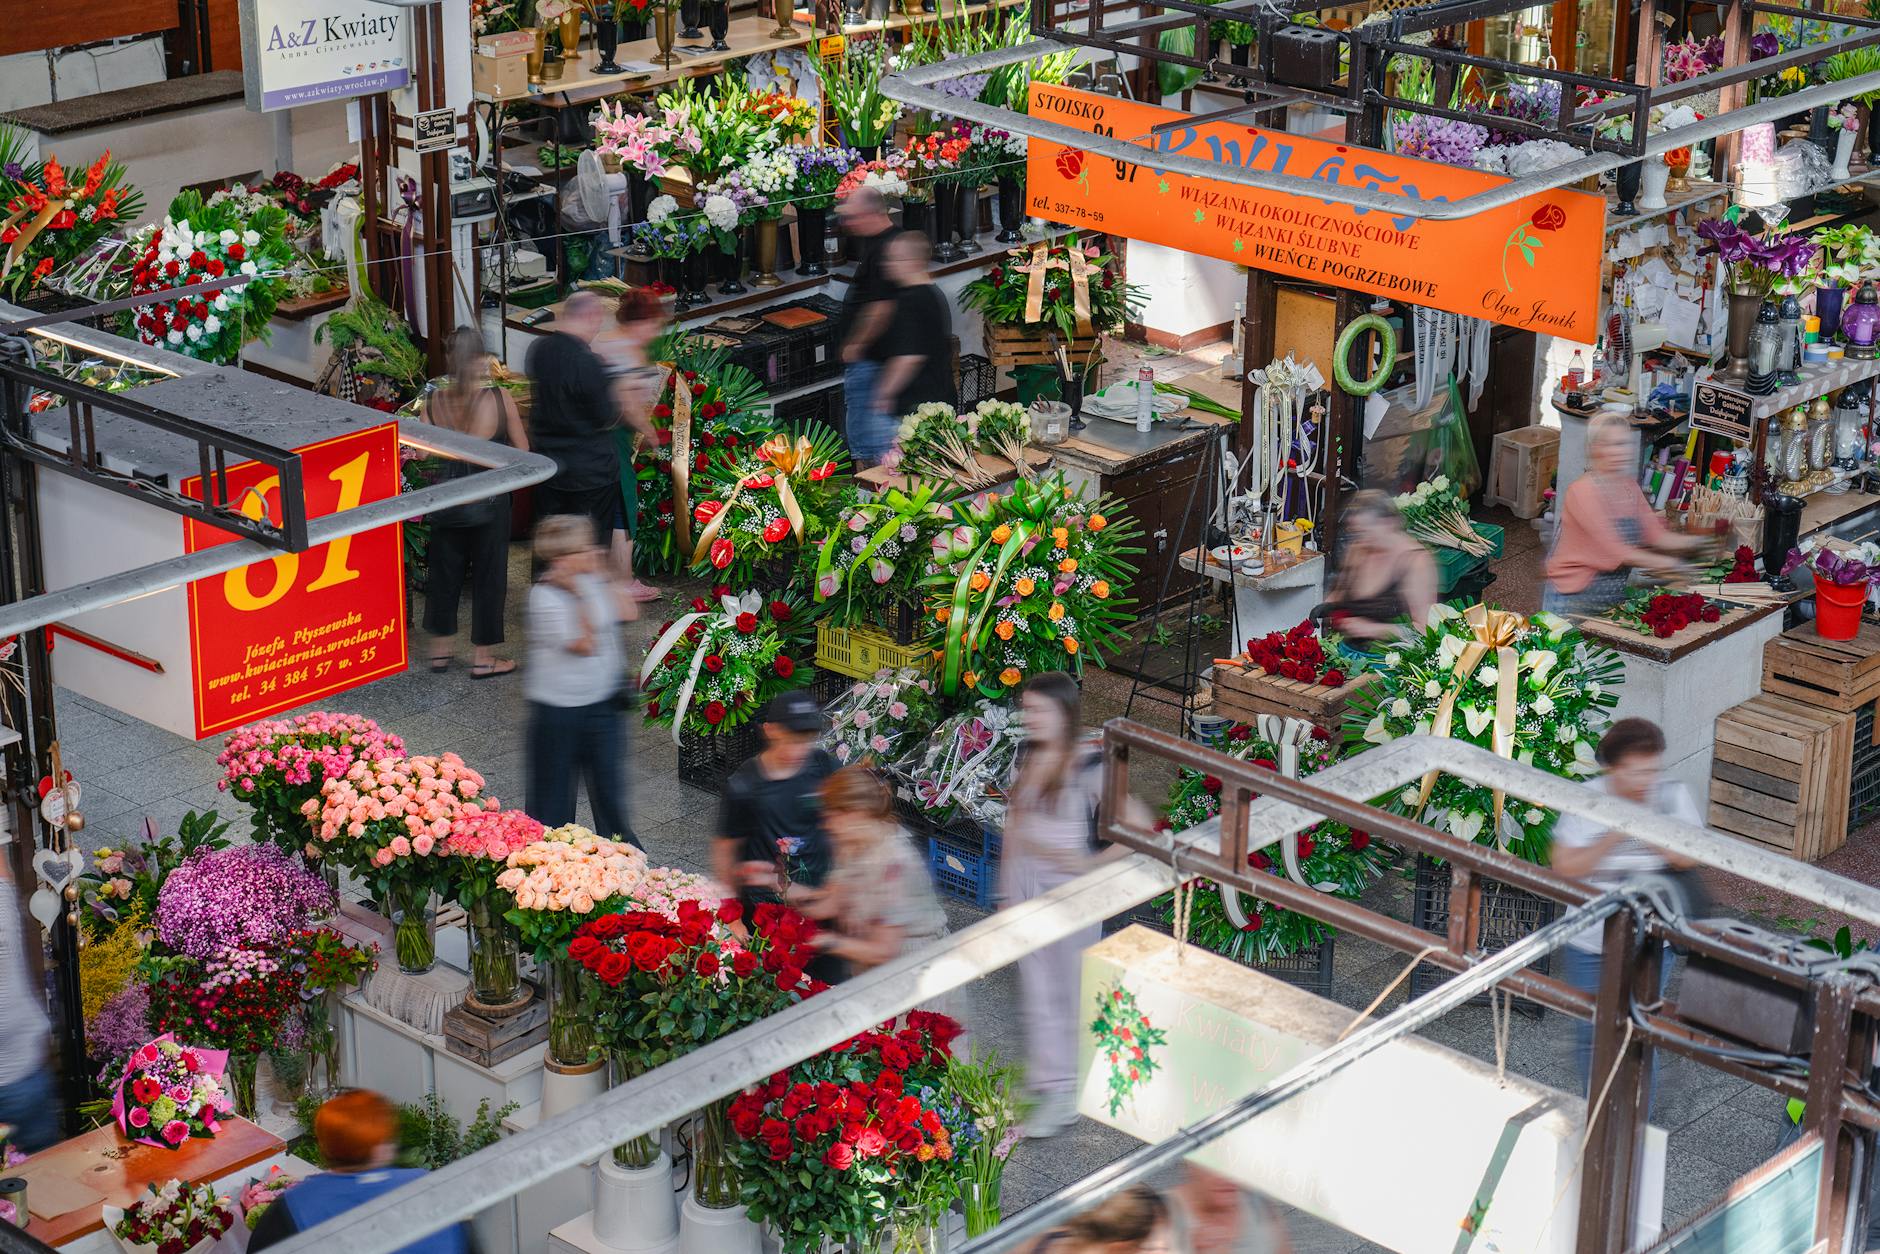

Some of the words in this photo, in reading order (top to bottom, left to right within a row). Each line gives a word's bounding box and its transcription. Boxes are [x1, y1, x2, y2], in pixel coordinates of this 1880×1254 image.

[266, 19, 318, 51] A&Z
[323, 13, 399, 42] Kwiaty
[280, 51, 308, 60] Anna
[316, 39, 376, 54] Ciszewska
[1035, 92, 1104, 121] STOISKO
[1032, 196, 1050, 210] tel.
[1054, 203, 1104, 222] 337-78-59
[1259, 202, 1421, 250] OKOLICZNOŚCIOWE
[1216, 214, 1293, 246] WIĄZANKI
[1296, 232, 1362, 259] ŚLUBNE
[1255, 243, 1318, 272] WIEŃCE
[1322, 260, 1438, 298] POGRZEBOWE
[1482, 289, 1520, 321] Olga
[1519, 300, 1576, 329] Janik
[224, 451, 369, 611] 81
[243, 636, 285, 663] Józefa
[292, 611, 363, 645] Płyszewska
[230, 685, 251, 704] tel.
[259, 678, 277, 695] 34
[283, 666, 309, 688] 384
[315, 659, 332, 678] 57
[338, 656, 352, 669] w.
[360, 646, 376, 664] 35
[1178, 1000, 1281, 1073] Kwiaty
